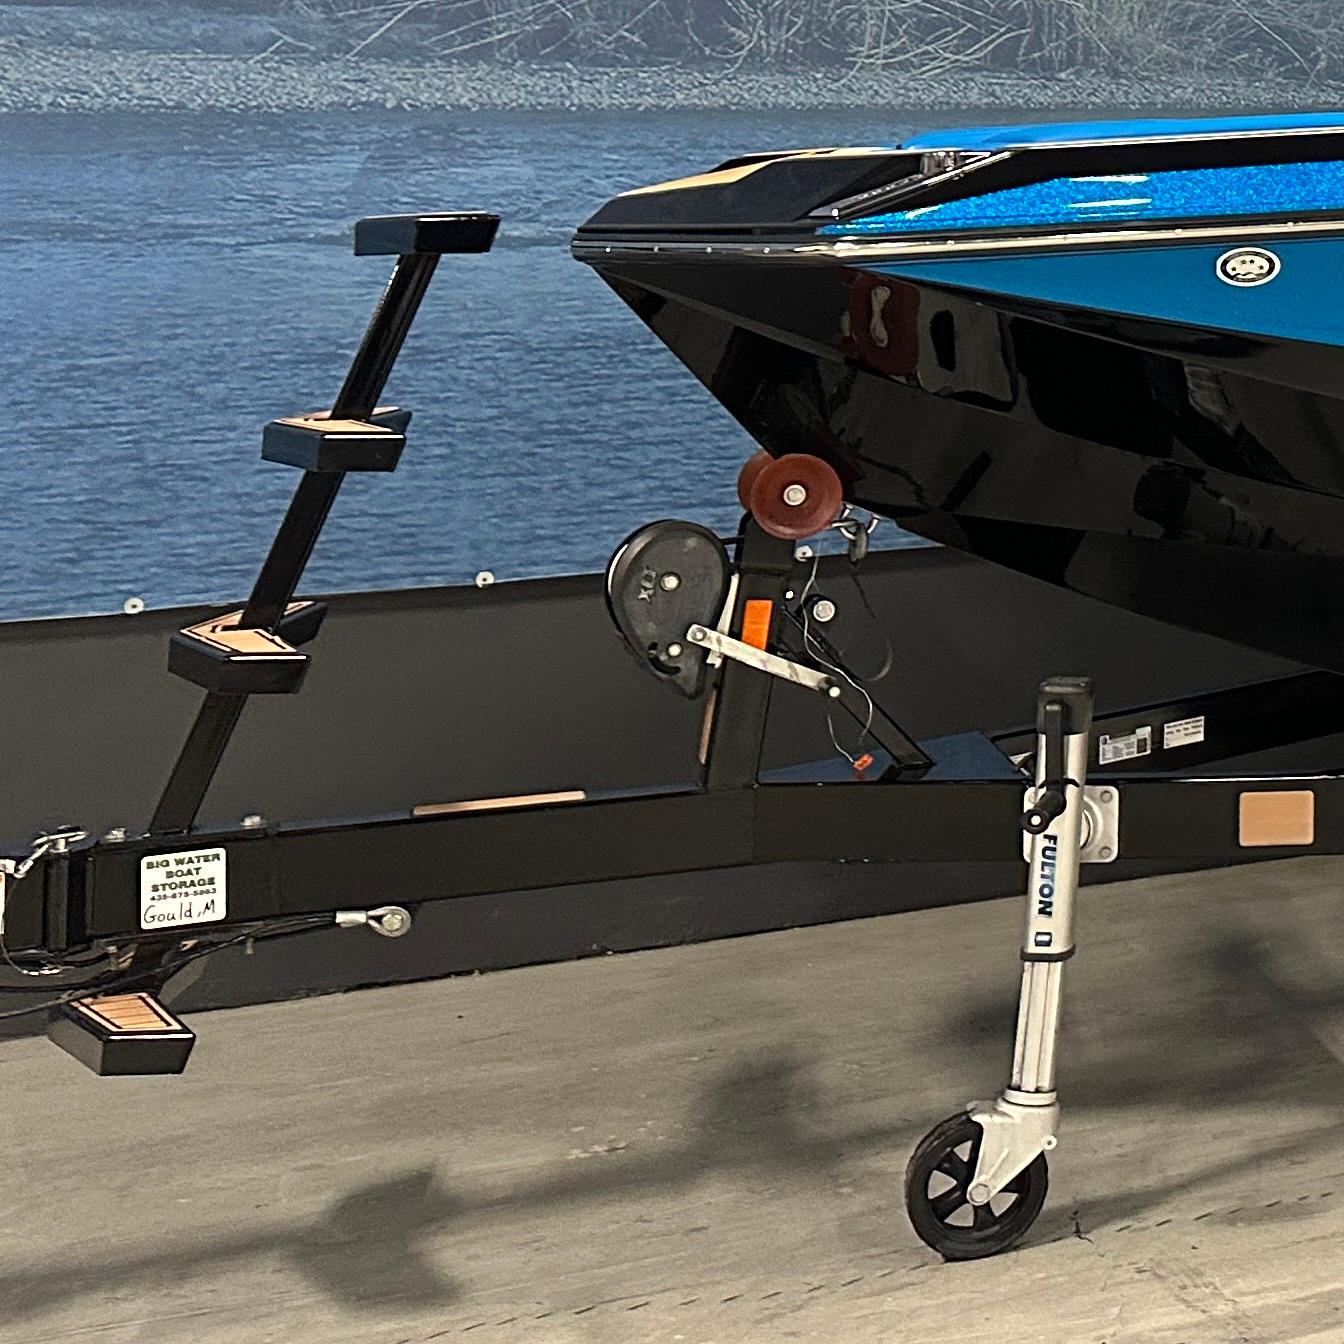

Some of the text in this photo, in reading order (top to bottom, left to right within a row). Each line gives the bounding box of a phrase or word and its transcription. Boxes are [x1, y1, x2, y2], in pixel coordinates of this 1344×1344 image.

[146, 853, 220, 870] BIG WATER
[165, 866, 202, 879] BOAT
[1037, 833, 1058, 918] FULTON
[151, 876, 216, 893] STORAGE
